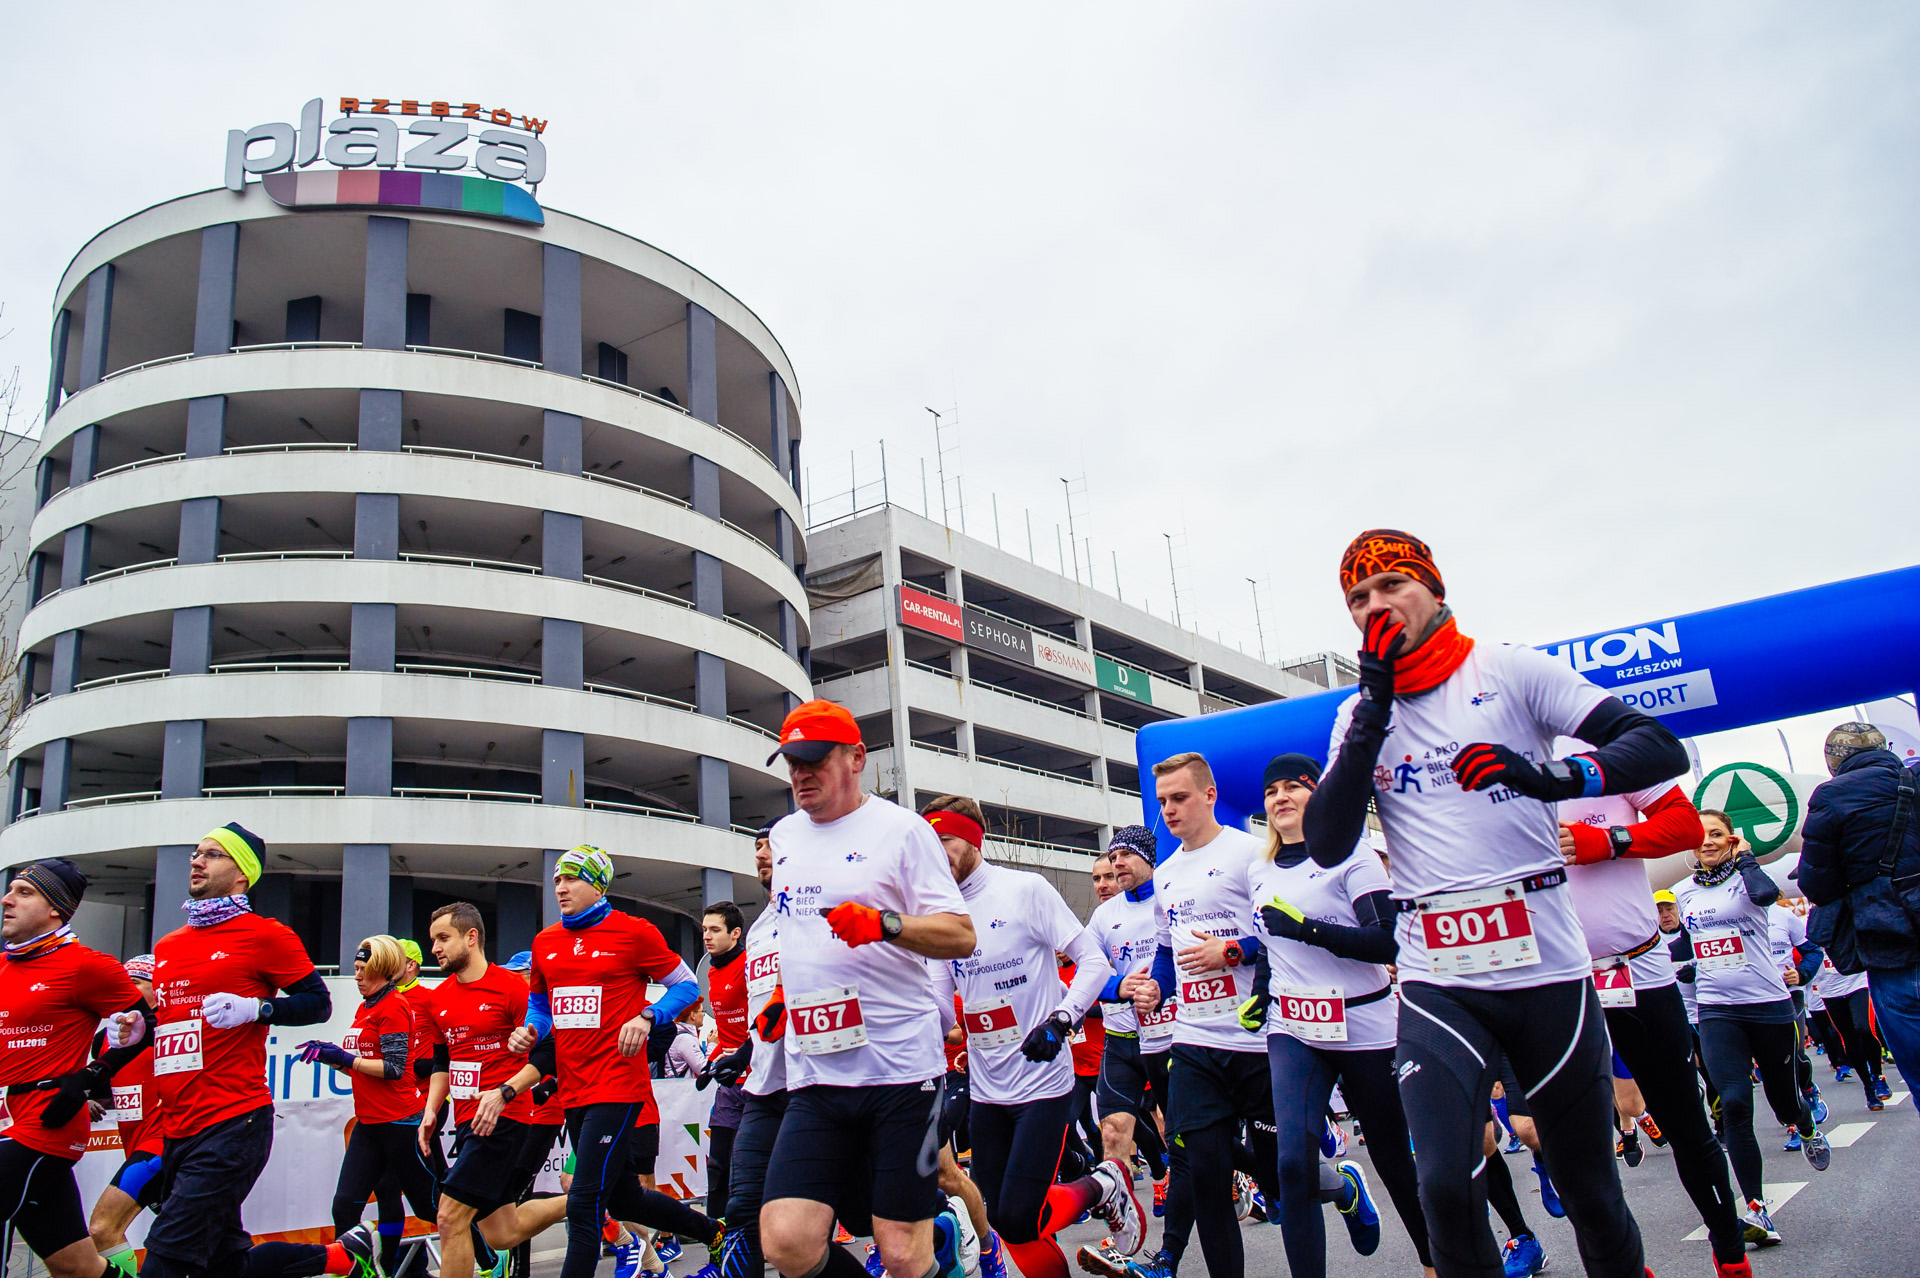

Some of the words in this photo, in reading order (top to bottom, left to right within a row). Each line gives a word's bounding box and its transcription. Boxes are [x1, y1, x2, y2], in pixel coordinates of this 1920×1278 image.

[340, 97, 548, 134] RZESZÓW
[224, 97, 547, 193] plaza
[903, 599, 961, 630] CAR-RENTAL.PL
[970, 620, 1027, 653] SEPHORA
[1037, 644, 1092, 676] ROSSMANN
[1616, 658, 1683, 680] RZESZÓW
[1117, 665, 1129, 685] D
[1622, 683, 1688, 710] PORT
[1435, 741, 1460, 758] PKO
[805, 885, 822, 895] PKO
[796, 896, 815, 906] BIEG
[1435, 907, 1509, 946] 901
[1141, 937, 1155, 946] PKO
[1700, 938, 1736, 957] 654
[754, 954, 780, 979] 646
[176, 979, 190, 988] PKO
[993, 974, 1028, 991] 11.11.2016
[1188, 979, 1228, 1002] 482
[555, 997, 598, 1015] 1388
[1143, 1006, 1173, 1026] 395
[1287, 998, 1333, 1022] 900
[798, 1003, 847, 1033] 767
[979, 1013, 994, 1031] 9
[7, 1037, 48, 1049] 11.11.2016
[155, 1032, 198, 1058] 1170
[473, 1042, 501, 1051] 11.11.2016
[452, 1071, 474, 1086] 769
